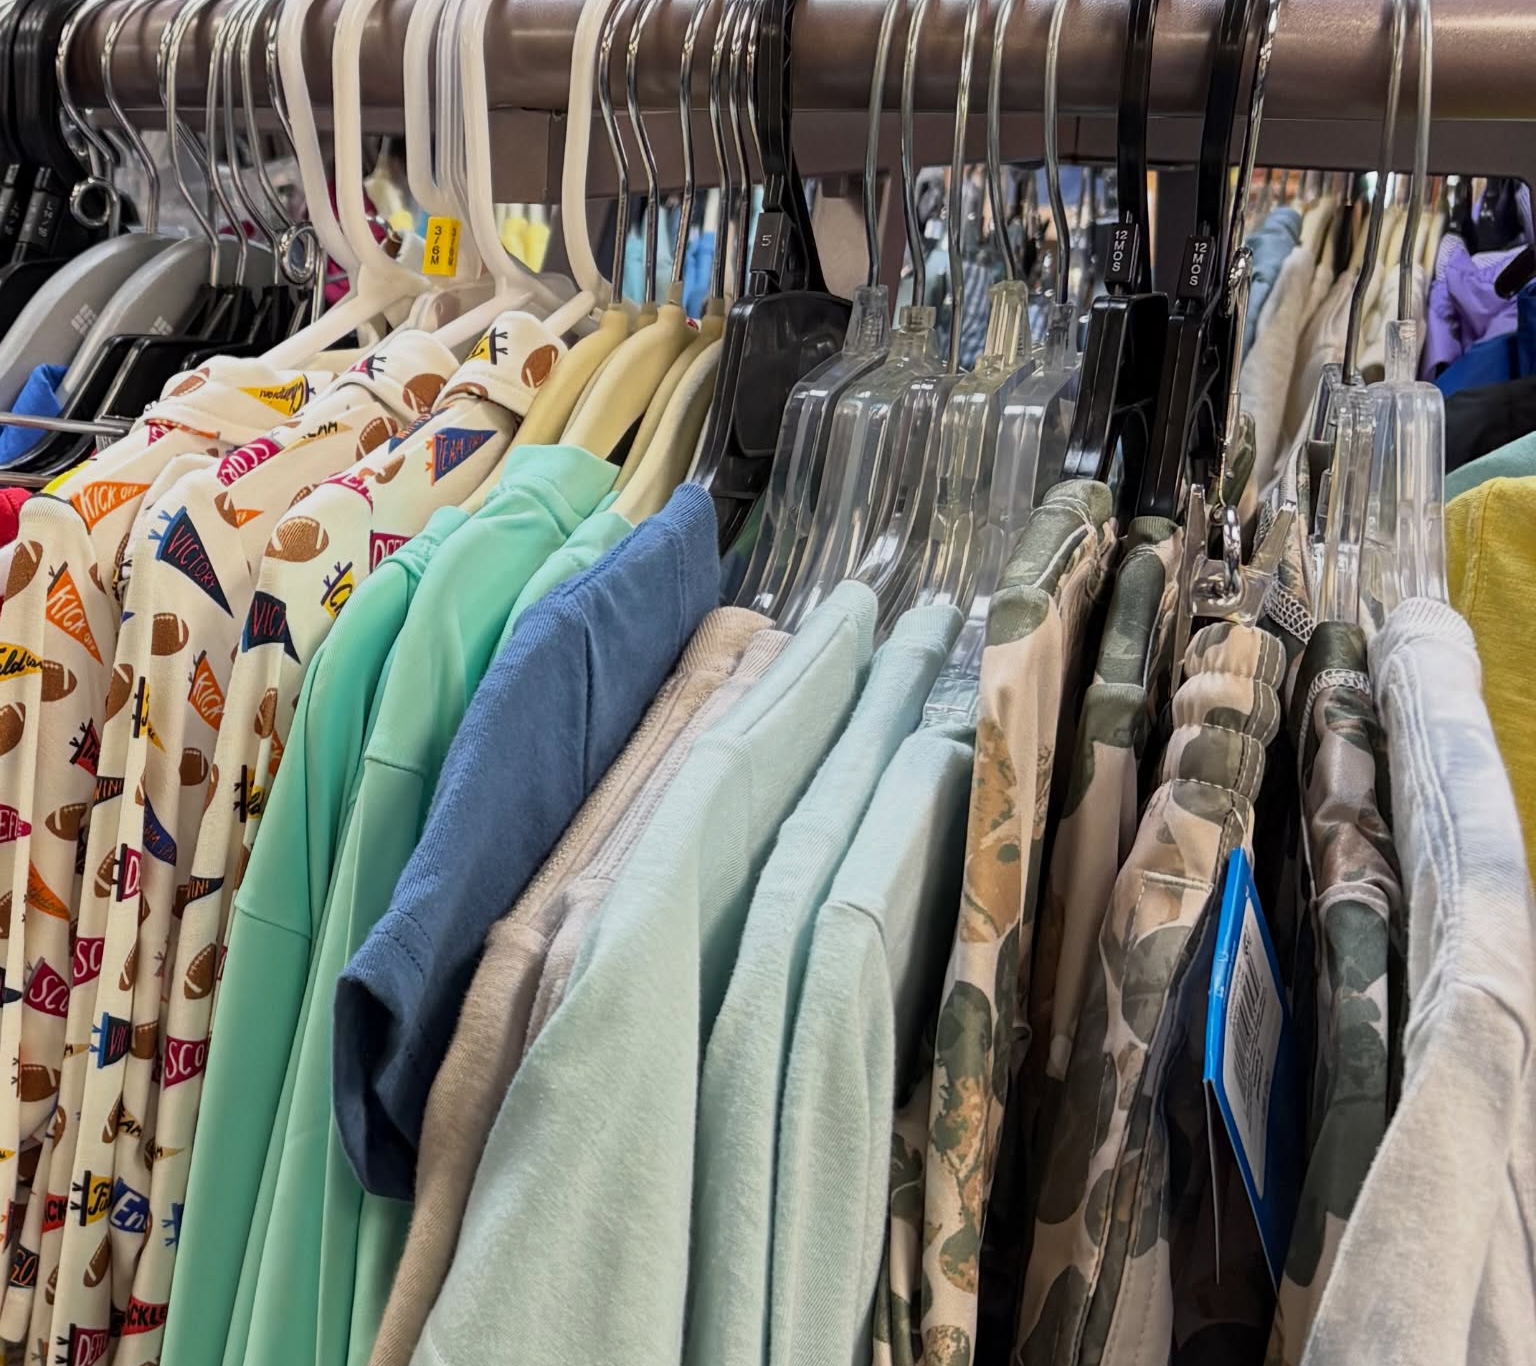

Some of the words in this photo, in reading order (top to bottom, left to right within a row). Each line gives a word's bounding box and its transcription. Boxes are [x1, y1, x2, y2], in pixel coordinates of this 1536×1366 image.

[430, 225, 442, 266] 3/6M
[761, 235, 772, 246] 5
[1115, 230, 1128, 240] 12
[1195, 242, 1207, 252] 12
[78, 485, 115, 520] KICK
[167, 524, 218, 590] VICTORY
[47, 584, 87, 636] KICK
